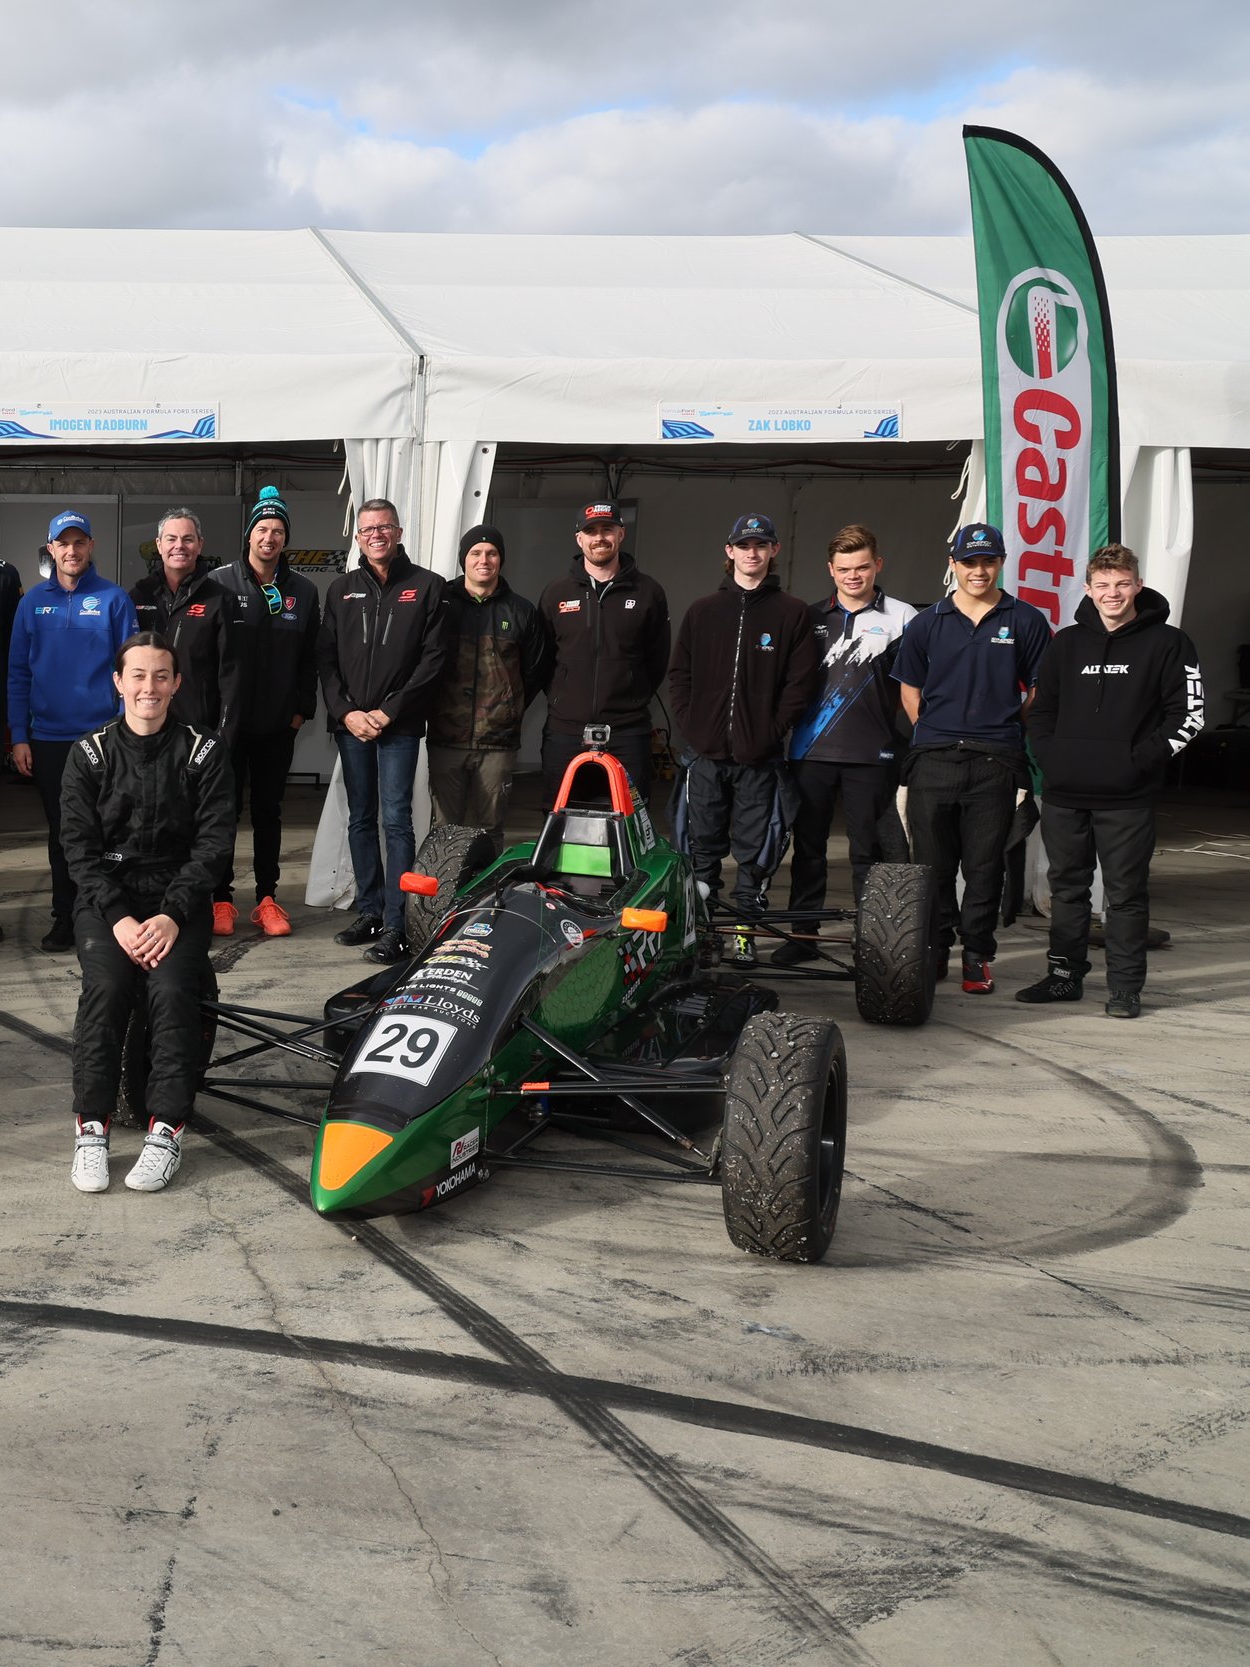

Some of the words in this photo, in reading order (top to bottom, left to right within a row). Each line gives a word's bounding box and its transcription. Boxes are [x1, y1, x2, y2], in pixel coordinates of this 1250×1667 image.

[50, 419, 91, 431] IMOGEN
[95, 419, 148, 431] RADBURN
[748, 419, 771, 431] ZAK
[774, 419, 811, 431] LOBKO
[1013, 388, 1082, 642] Castr
[35, 606, 58, 615] BRT
[1168, 662, 1205, 757] ALTATEK
[194, 739, 216, 764] sparco
[408, 968, 473, 981] KERDEN
[396, 984, 417, 992] FIVE
[419, 984, 457, 992] LIGHTS
[423, 995, 481, 1023] Lloyds
[434, 1009, 477, 1029] AUCTIONS
[364, 1023, 440, 1068] 29
[436, 1162, 476, 1197] YOKOHAMA
